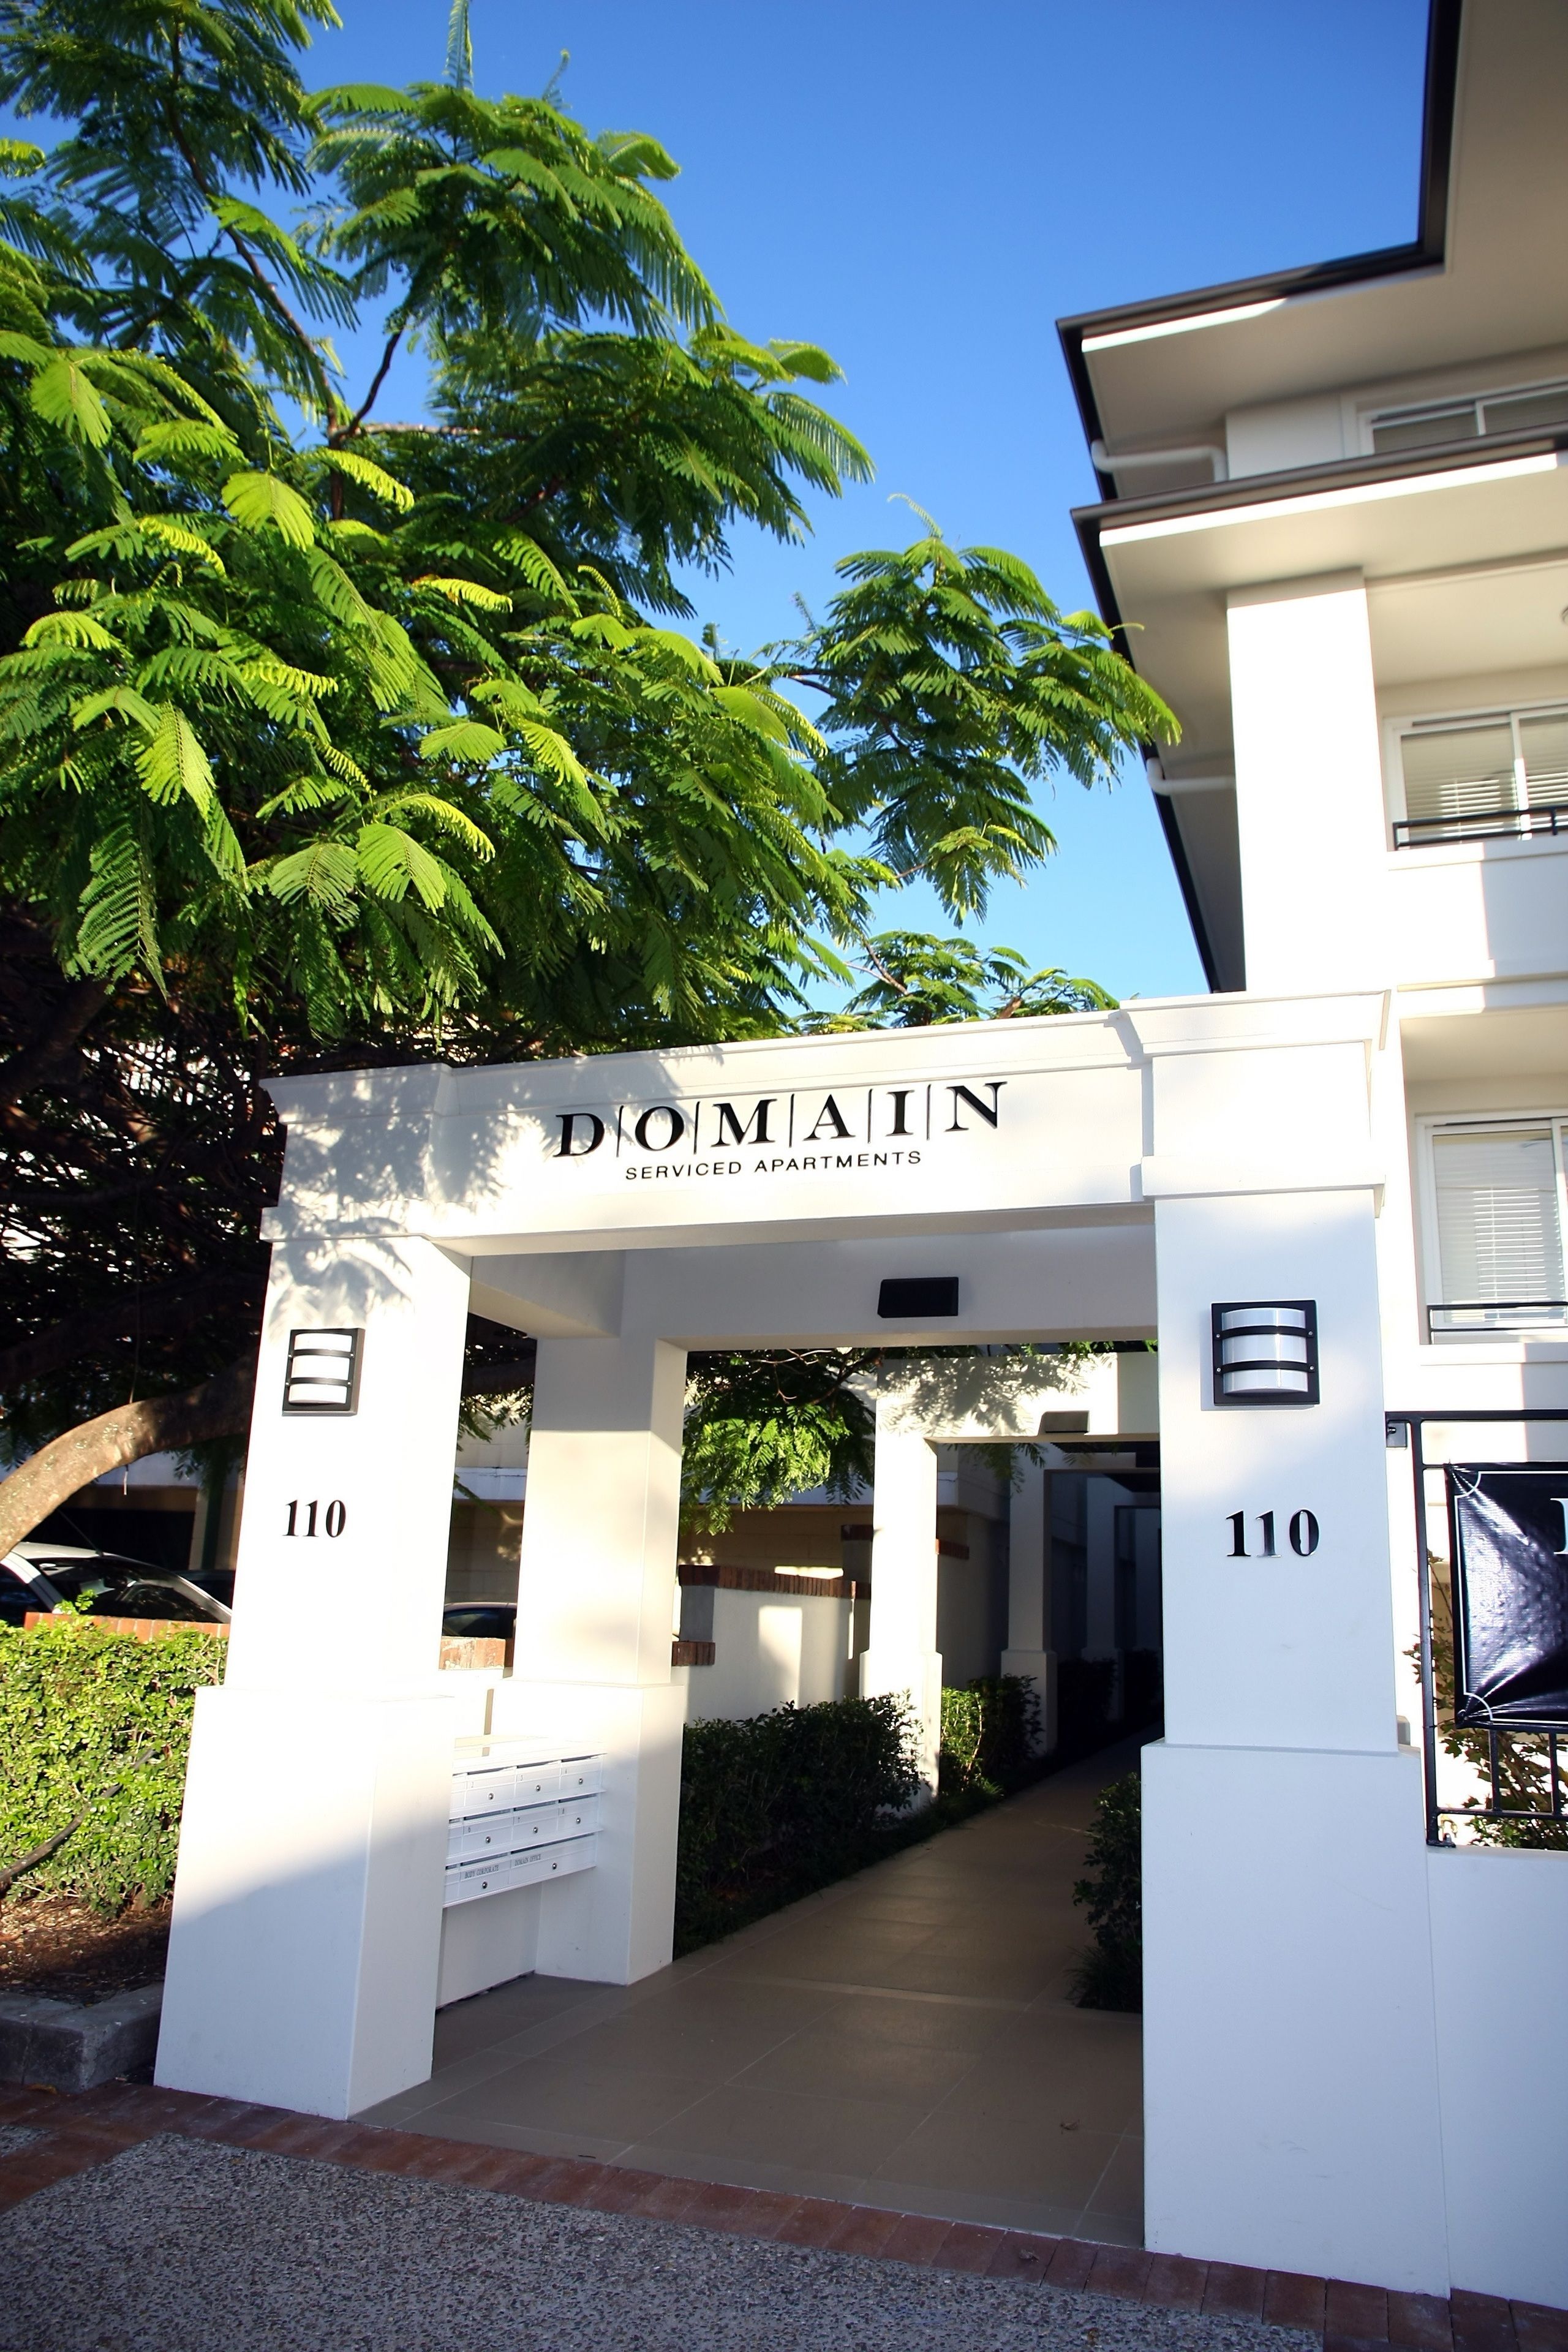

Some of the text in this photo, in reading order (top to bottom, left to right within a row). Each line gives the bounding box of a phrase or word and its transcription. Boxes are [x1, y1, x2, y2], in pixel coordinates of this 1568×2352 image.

[625, 1150, 922, 1181] SERVICED APARTMENTS
[282, 1499, 347, 1538] 110
[1226, 1509, 1320, 1558] 110
